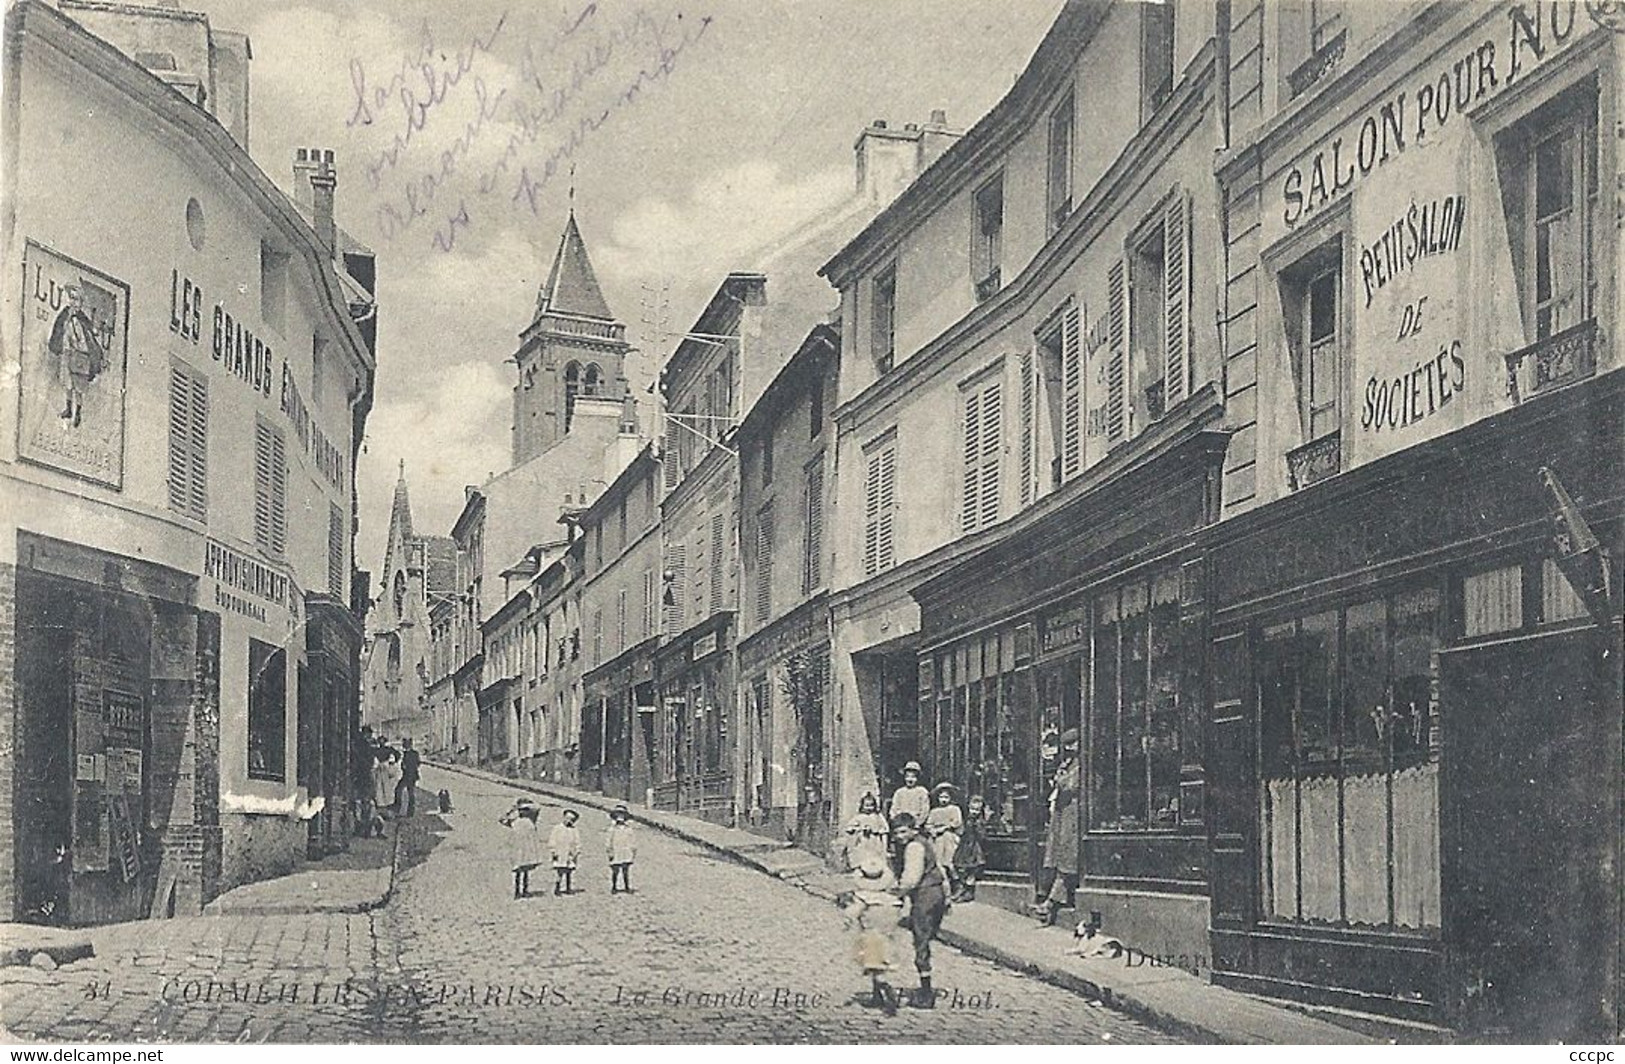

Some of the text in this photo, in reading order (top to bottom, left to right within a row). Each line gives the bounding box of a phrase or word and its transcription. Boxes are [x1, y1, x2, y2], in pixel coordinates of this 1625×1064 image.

[1282, 91, 1406, 230] SALON
[1414, 39, 1500, 143] POUR
[34, 263, 64, 311] LU
[1359, 195, 1466, 309] PETIT SALON
[169, 268, 273, 399] LES GRANDS
[1399, 296, 1429, 342] DE
[1361, 339, 1465, 433] SOCIÉTÉS
